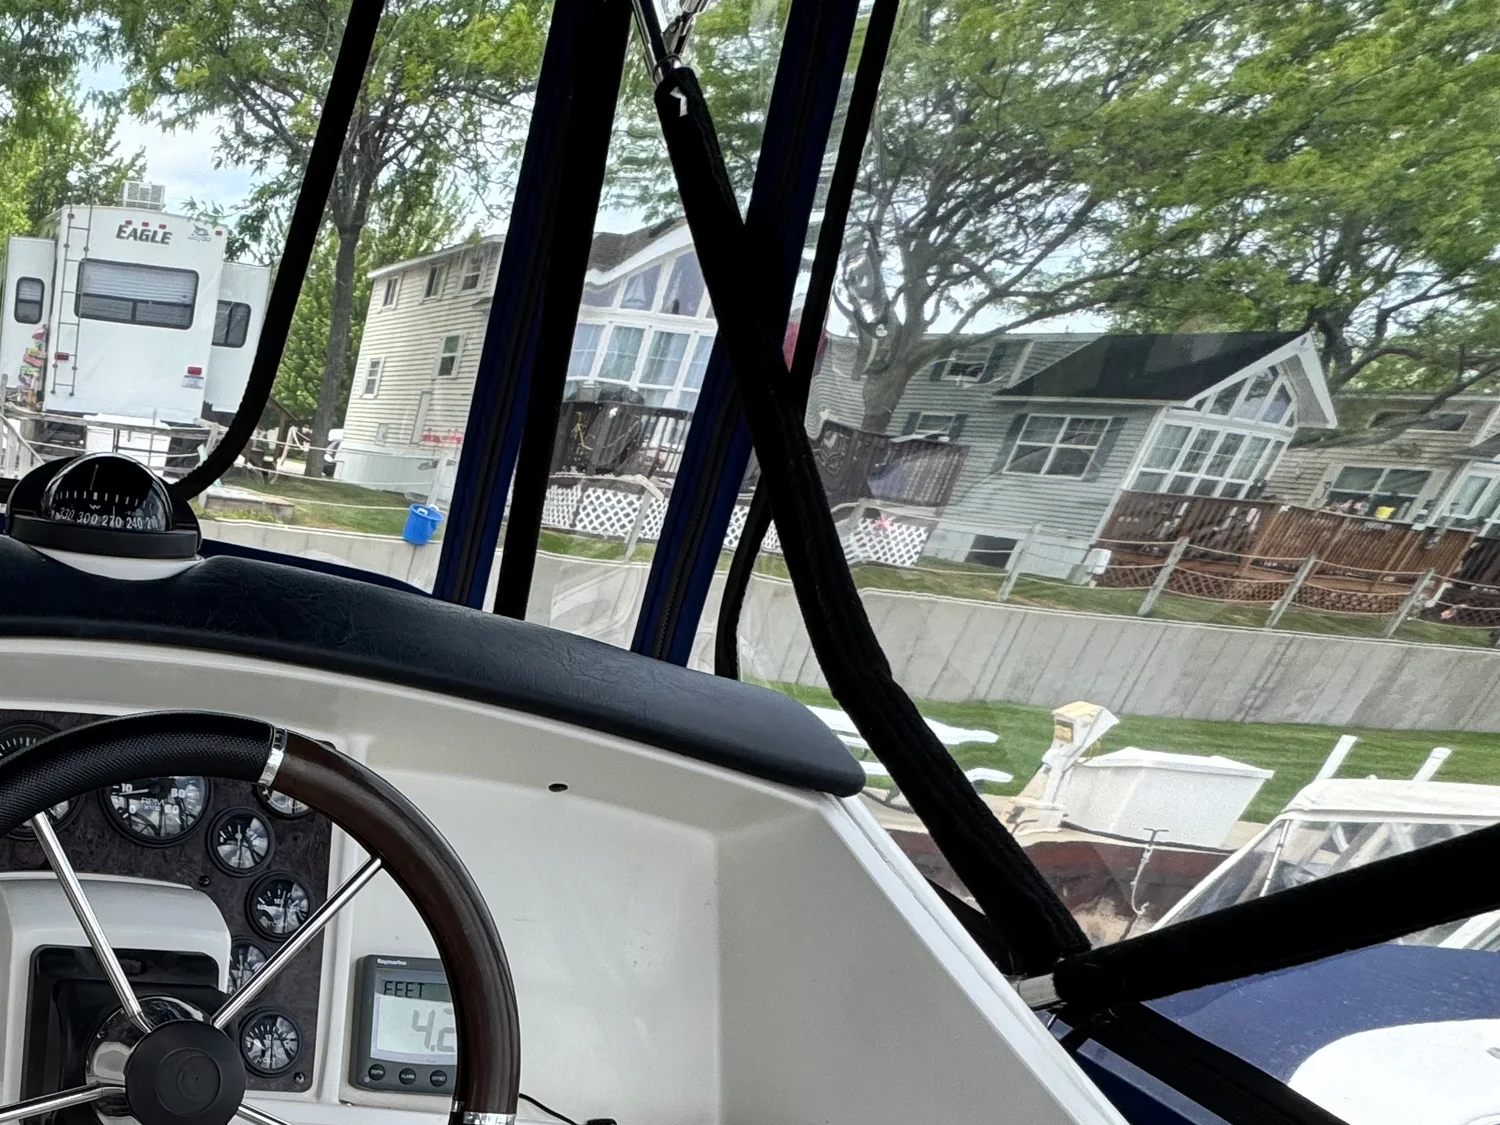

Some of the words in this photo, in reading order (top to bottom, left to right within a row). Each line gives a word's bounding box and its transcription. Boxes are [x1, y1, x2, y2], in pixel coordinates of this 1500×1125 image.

[116, 224, 173, 245] EAGLE
[77, 512, 98, 524] 300
[102, 515, 120, 527] 270
[126, 517, 143, 529] 240
[121, 783, 133, 792] 10
[141, 797, 164, 805] RPM
[129, 805, 136, 814] 0
[384, 981, 424, 998] FEET
